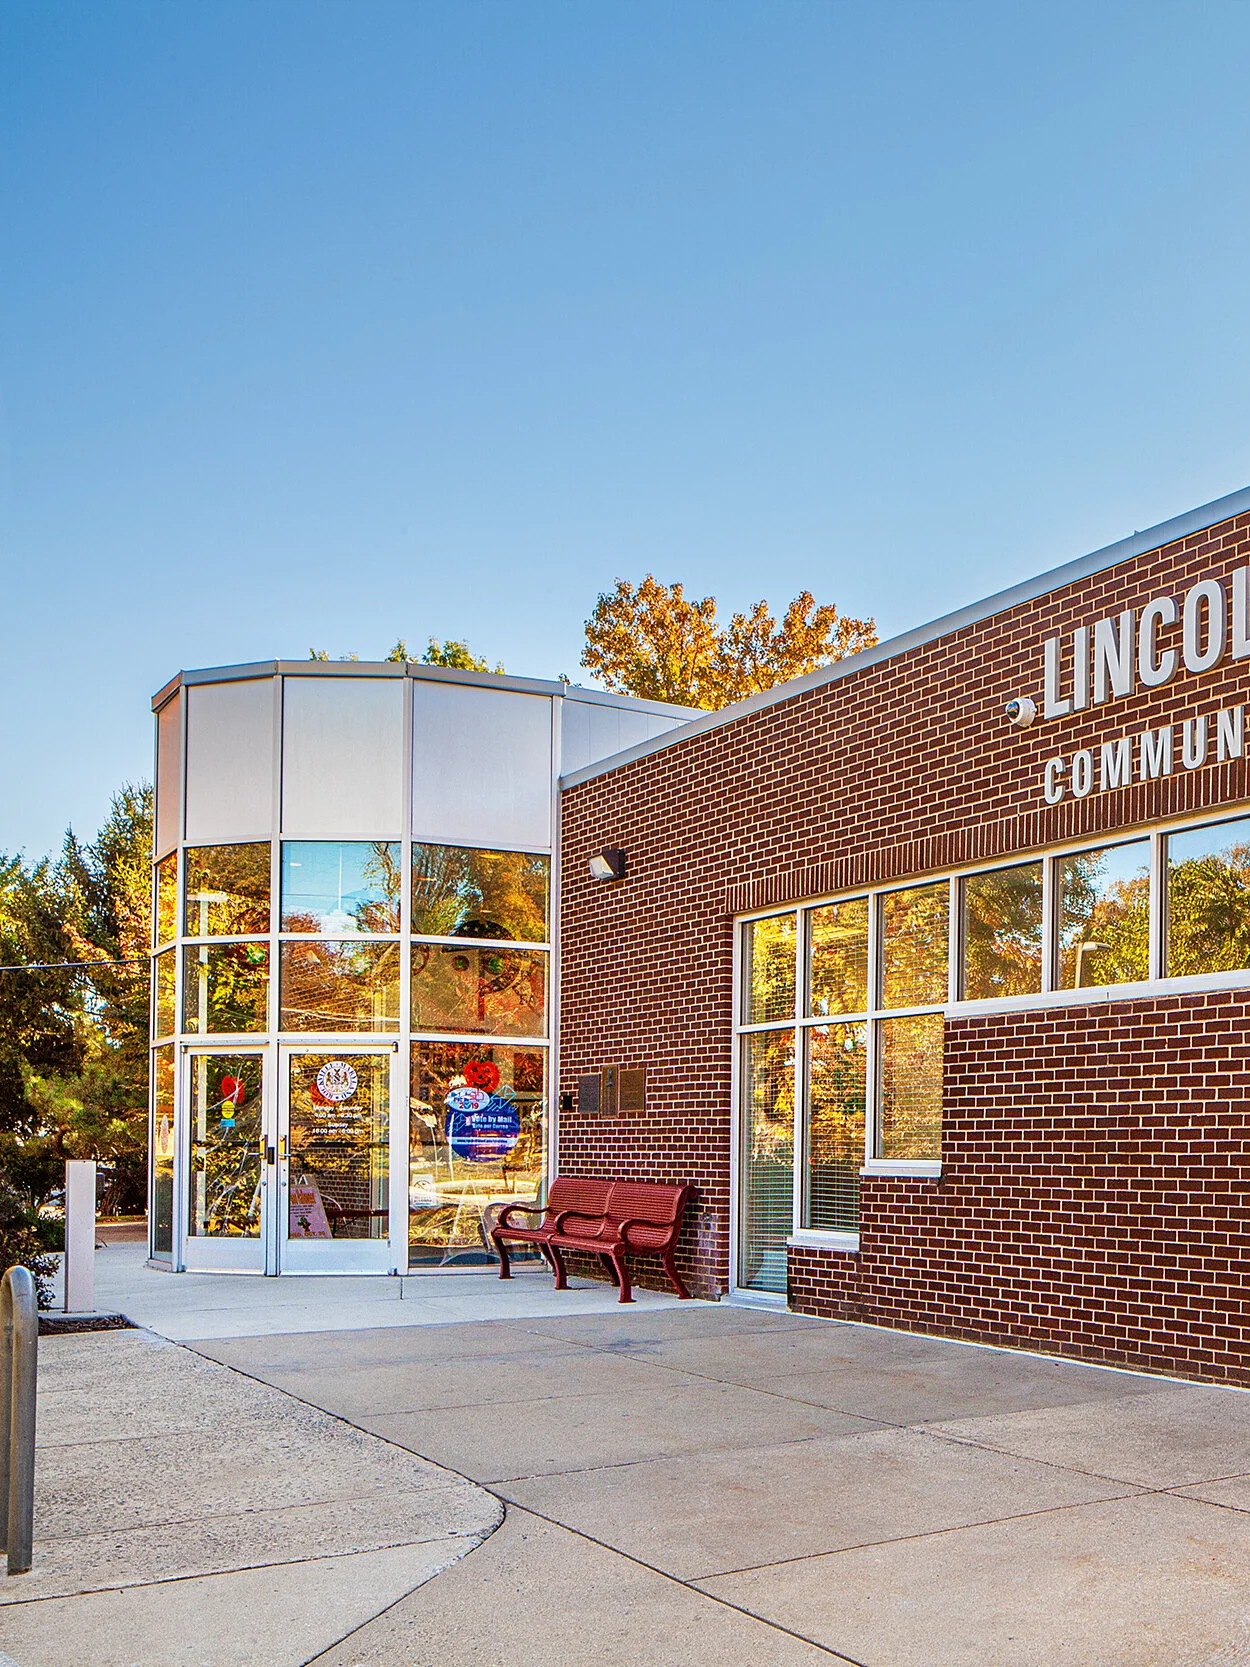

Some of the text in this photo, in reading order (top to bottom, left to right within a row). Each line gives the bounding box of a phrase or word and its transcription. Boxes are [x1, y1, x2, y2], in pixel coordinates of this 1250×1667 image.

[471, 1114, 512, 1124] Vote by Mail
